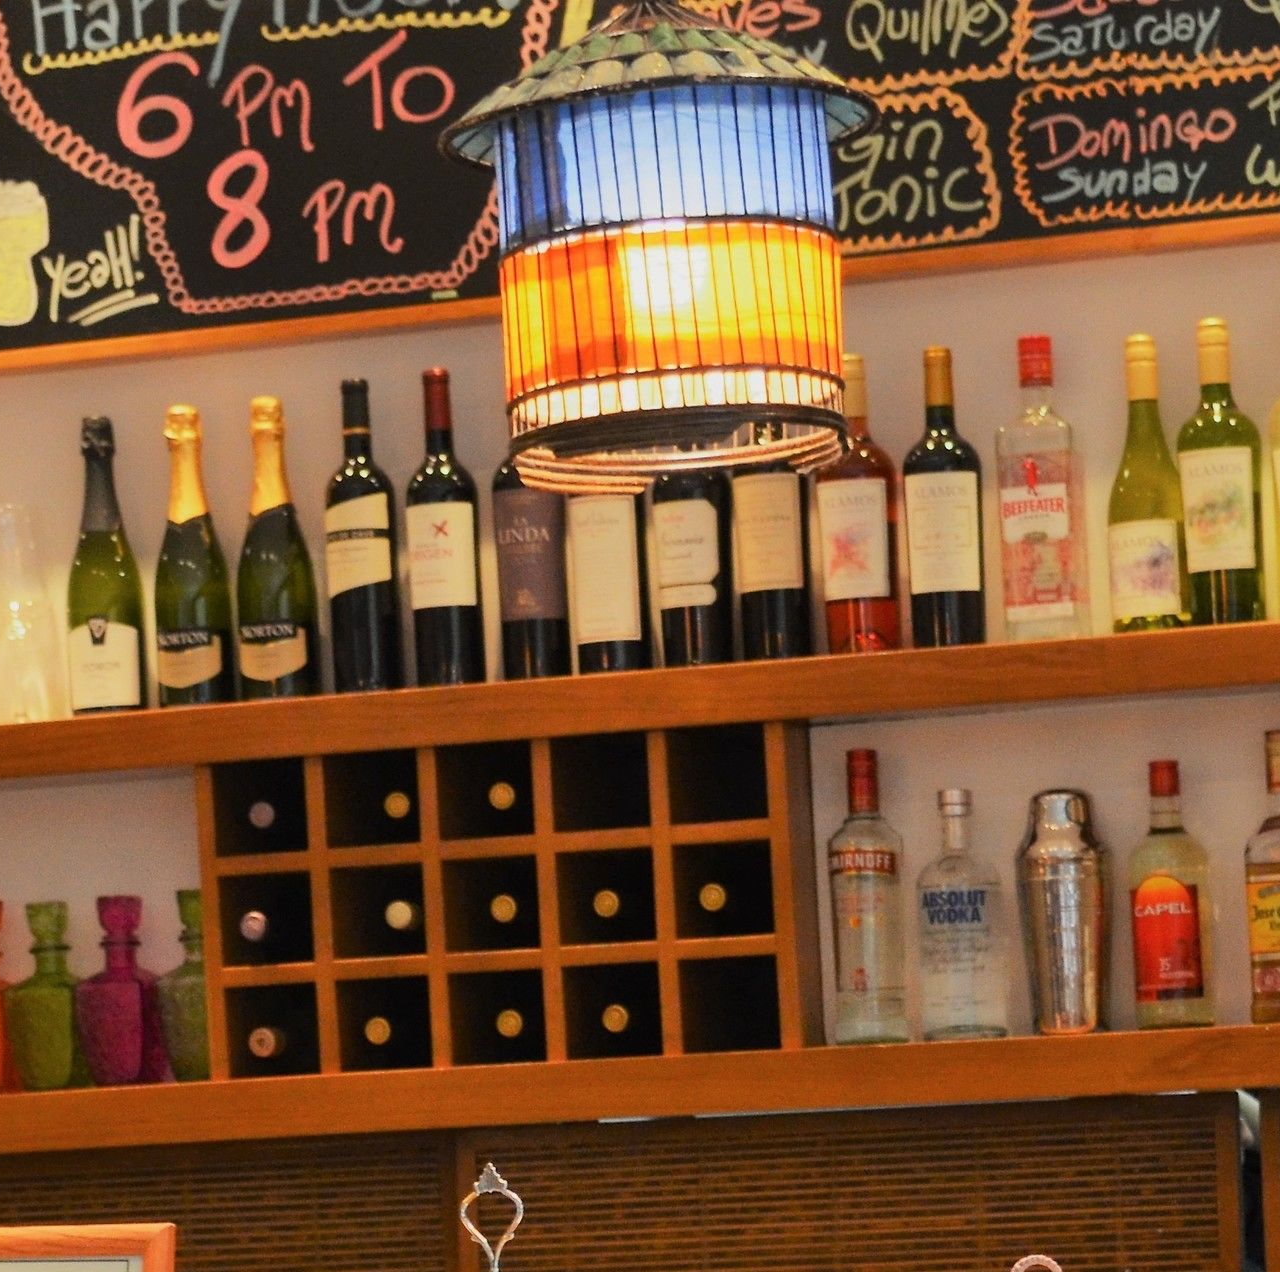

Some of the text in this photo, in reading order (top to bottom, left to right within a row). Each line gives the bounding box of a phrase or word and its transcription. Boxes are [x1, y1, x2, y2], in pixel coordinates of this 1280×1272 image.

[116, 51, 202, 158] 6
[207, 149, 272, 269] 8
[1002, 497, 1065, 519] BEEFEATER
[831, 852, 891, 870] MIRNOFF
[923, 890, 987, 908] ABSOLUT
[928, 907, 982, 925] VODKA
[1133, 902, 1191, 918] CAPEL
